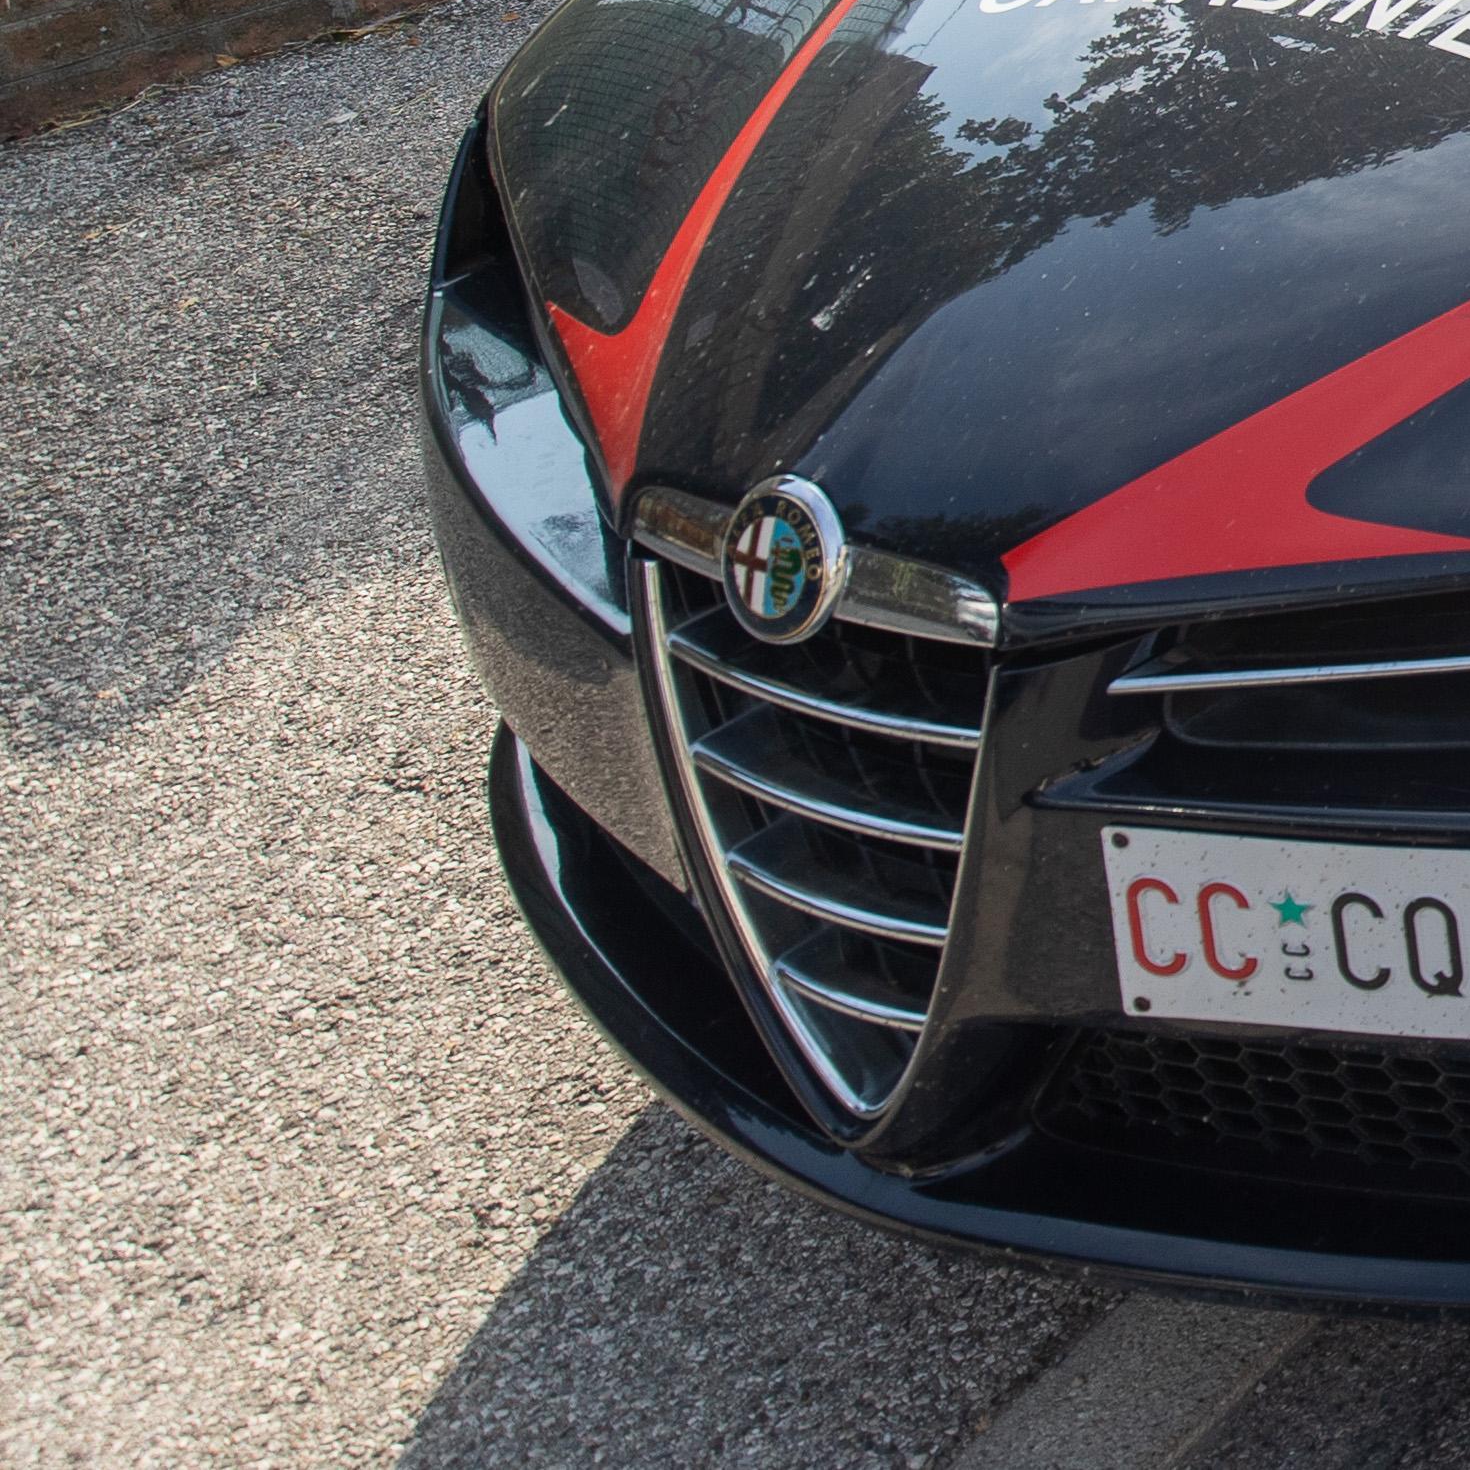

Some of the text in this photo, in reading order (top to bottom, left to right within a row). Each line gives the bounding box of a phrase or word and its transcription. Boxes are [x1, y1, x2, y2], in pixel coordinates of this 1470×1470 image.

[775, 500, 821, 580] ROMEO
[1126, 877, 1258, 981] CC
[1331, 892, 1465, 998] CQ
